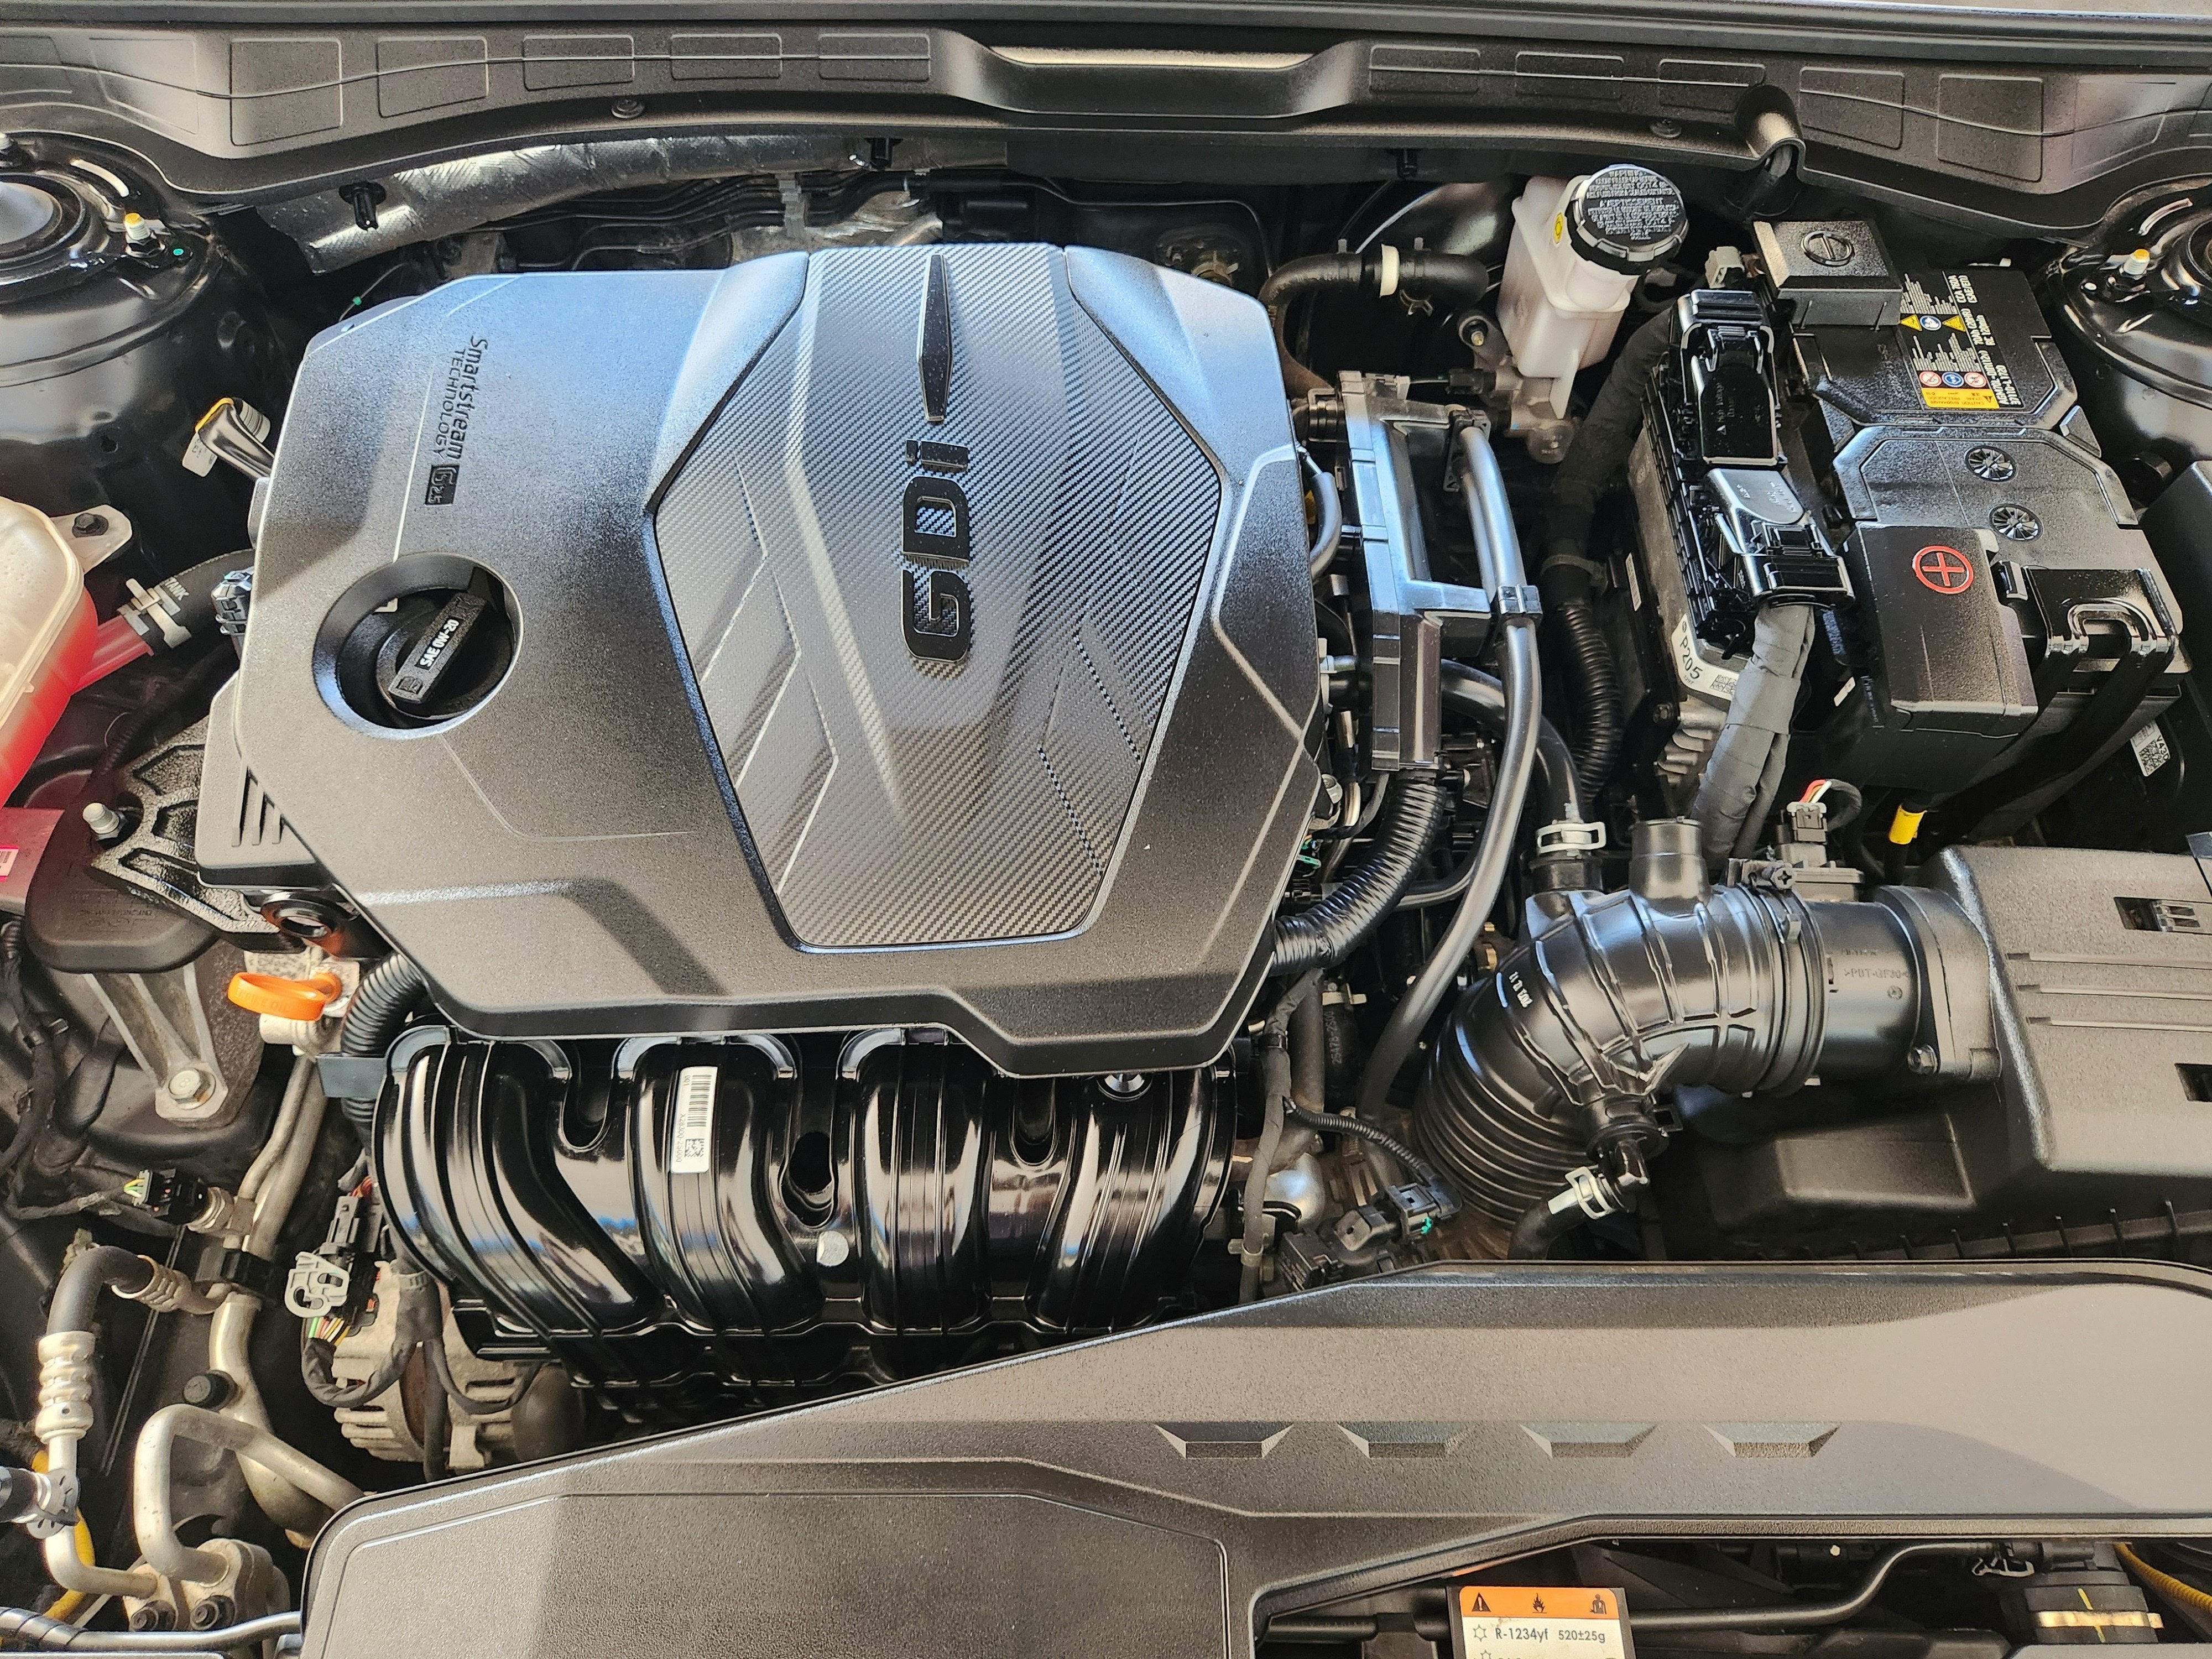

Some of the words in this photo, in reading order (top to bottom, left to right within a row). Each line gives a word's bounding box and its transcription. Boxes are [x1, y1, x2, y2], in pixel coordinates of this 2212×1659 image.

[433, 348, 466, 460] TECHNOLOGY
[447, 335, 488, 460] Smartstream
[420, 647, 440, 667] SAE
[432, 619, 460, 648] 0W-20
[1678, 639, 1704, 680] P205
[1495, 1627, 1548, 1643] R-1234yf
[1558, 1630, 1606, 1643] 520±25g
